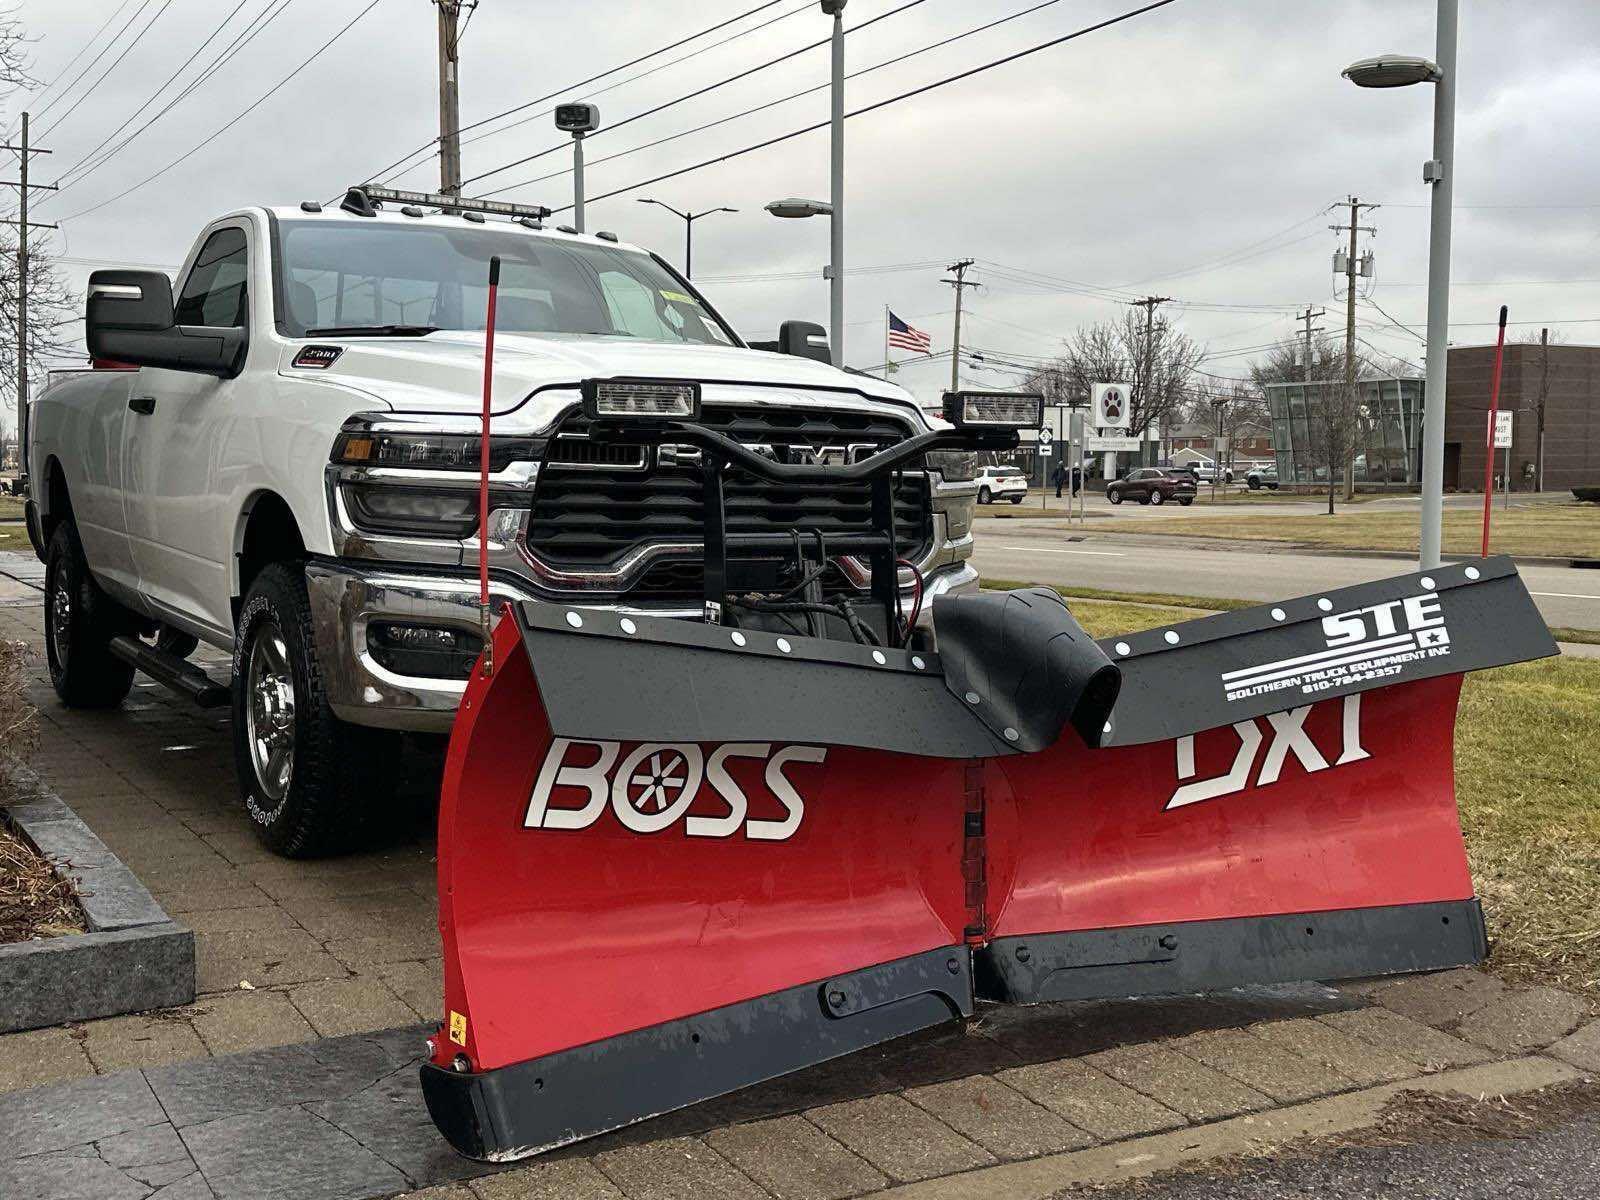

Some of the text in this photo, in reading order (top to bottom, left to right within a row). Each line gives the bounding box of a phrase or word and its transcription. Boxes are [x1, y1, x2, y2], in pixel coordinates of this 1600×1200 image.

[1322, 593, 1445, 648] STE
[1226, 645, 1451, 701] SOUTHERN TRUCK EQUIPMENT INC
[1301, 664, 1403, 694] 810-724-2357
[524, 737, 828, 840] BOSS
